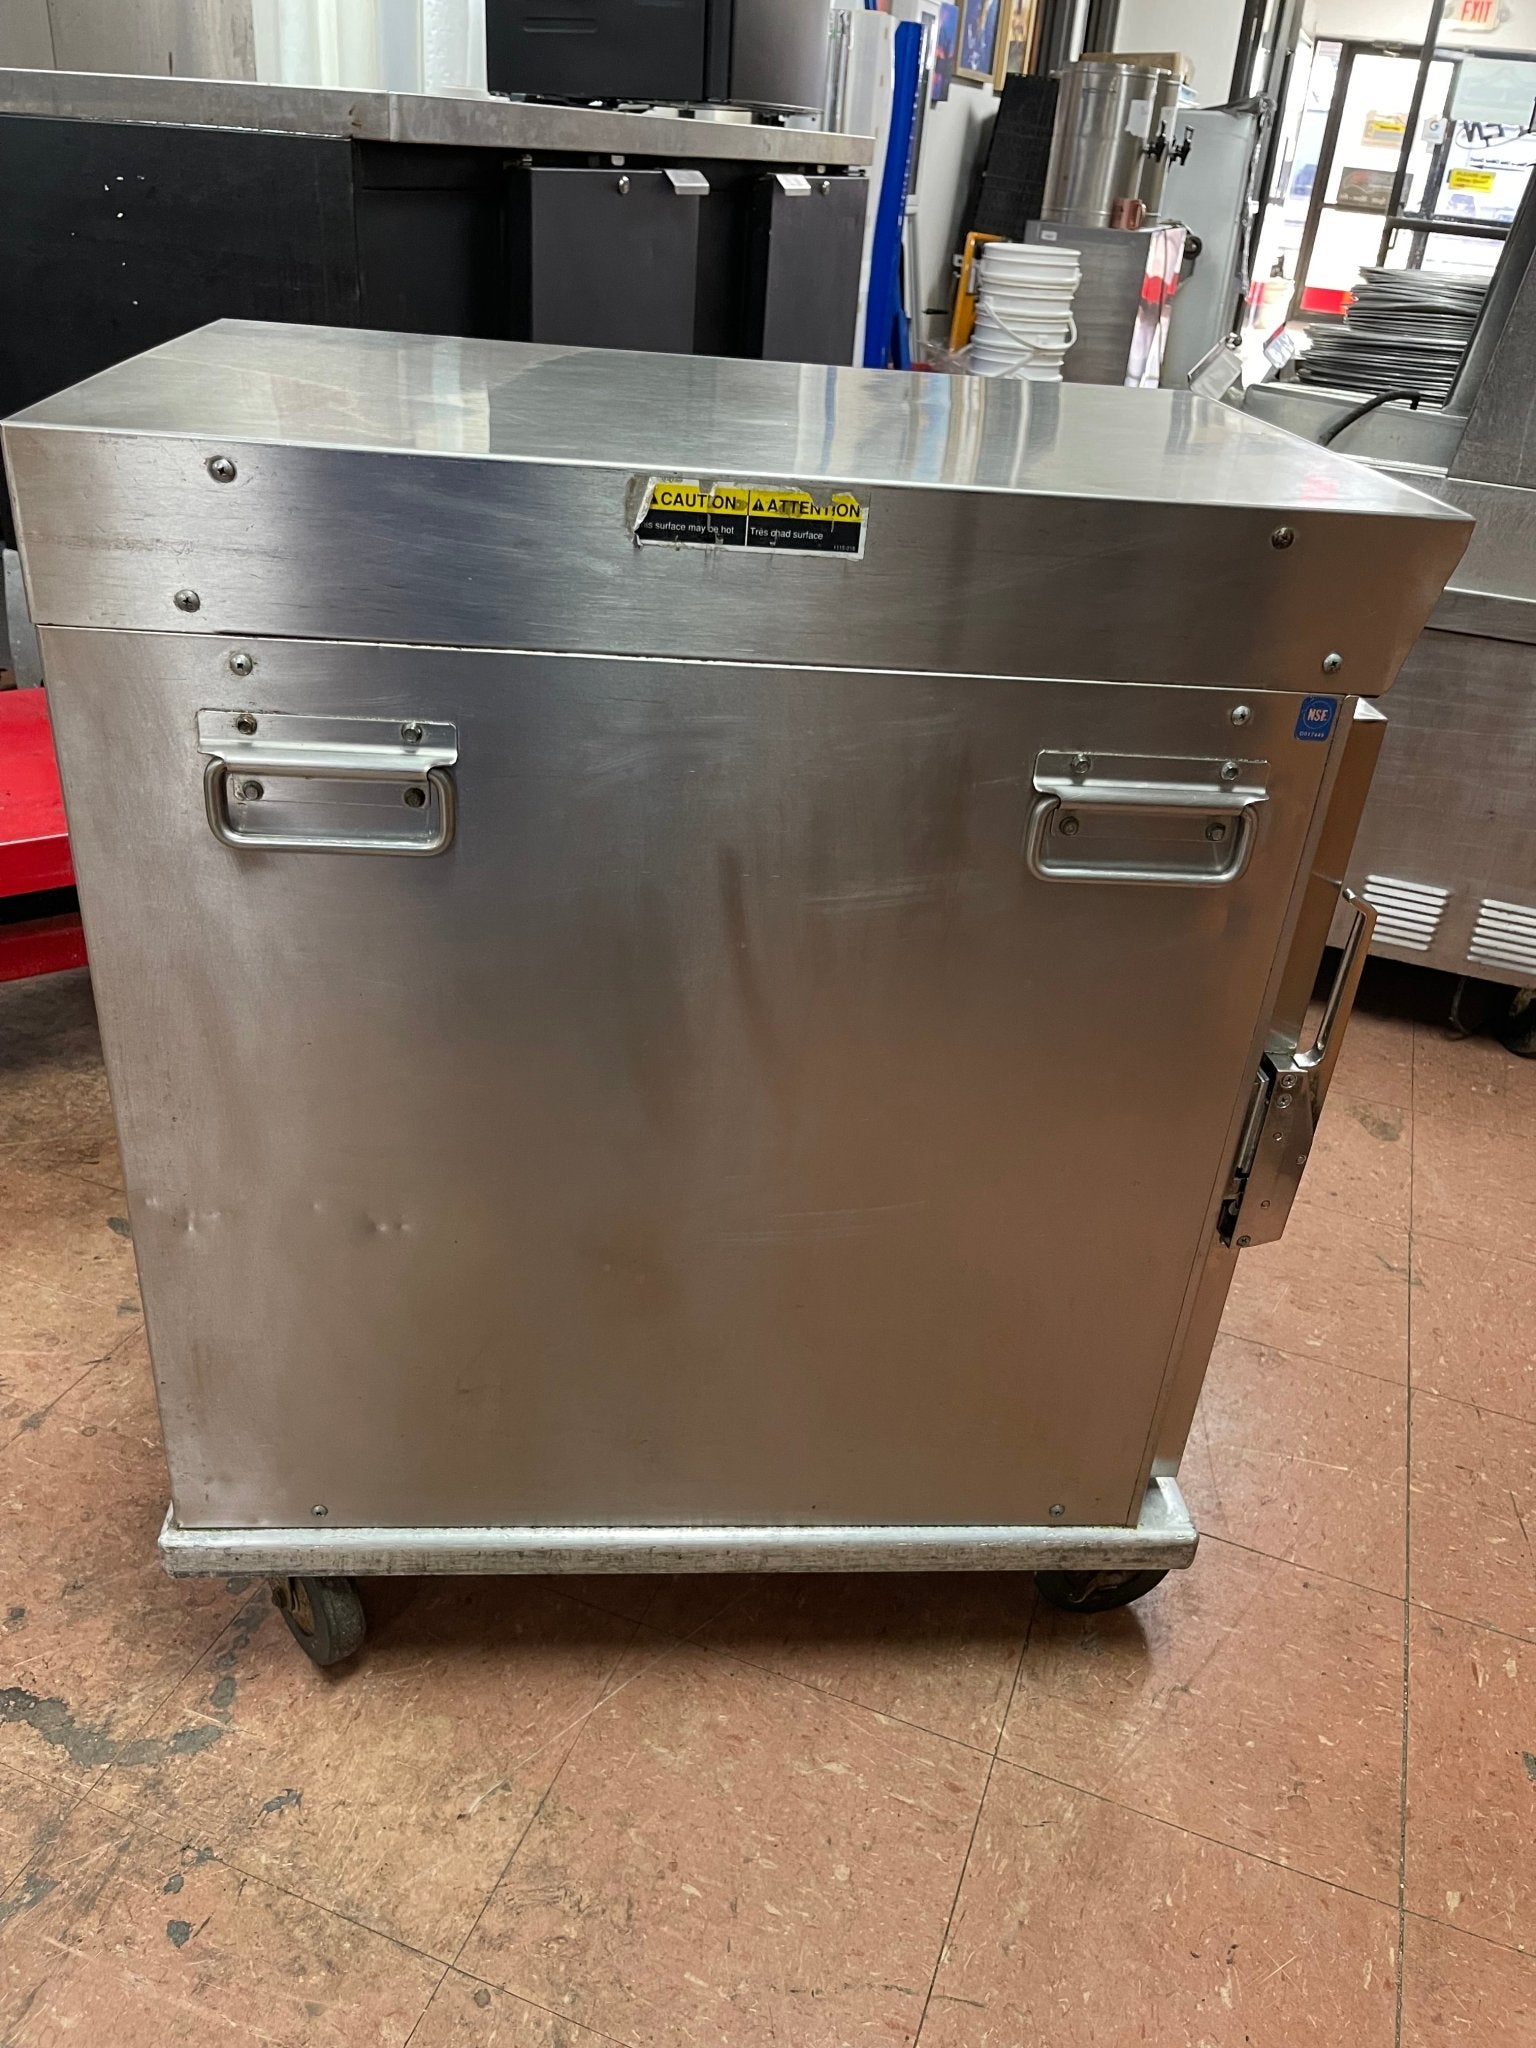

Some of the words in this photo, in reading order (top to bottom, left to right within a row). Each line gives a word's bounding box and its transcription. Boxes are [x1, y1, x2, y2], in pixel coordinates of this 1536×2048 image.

[1460, 0, 1493, 23] EXIT
[655, 521, 686, 531] surface
[688, 525, 706, 534] may
[720, 525, 734, 535] hot
[793, 530, 824, 540] surface
